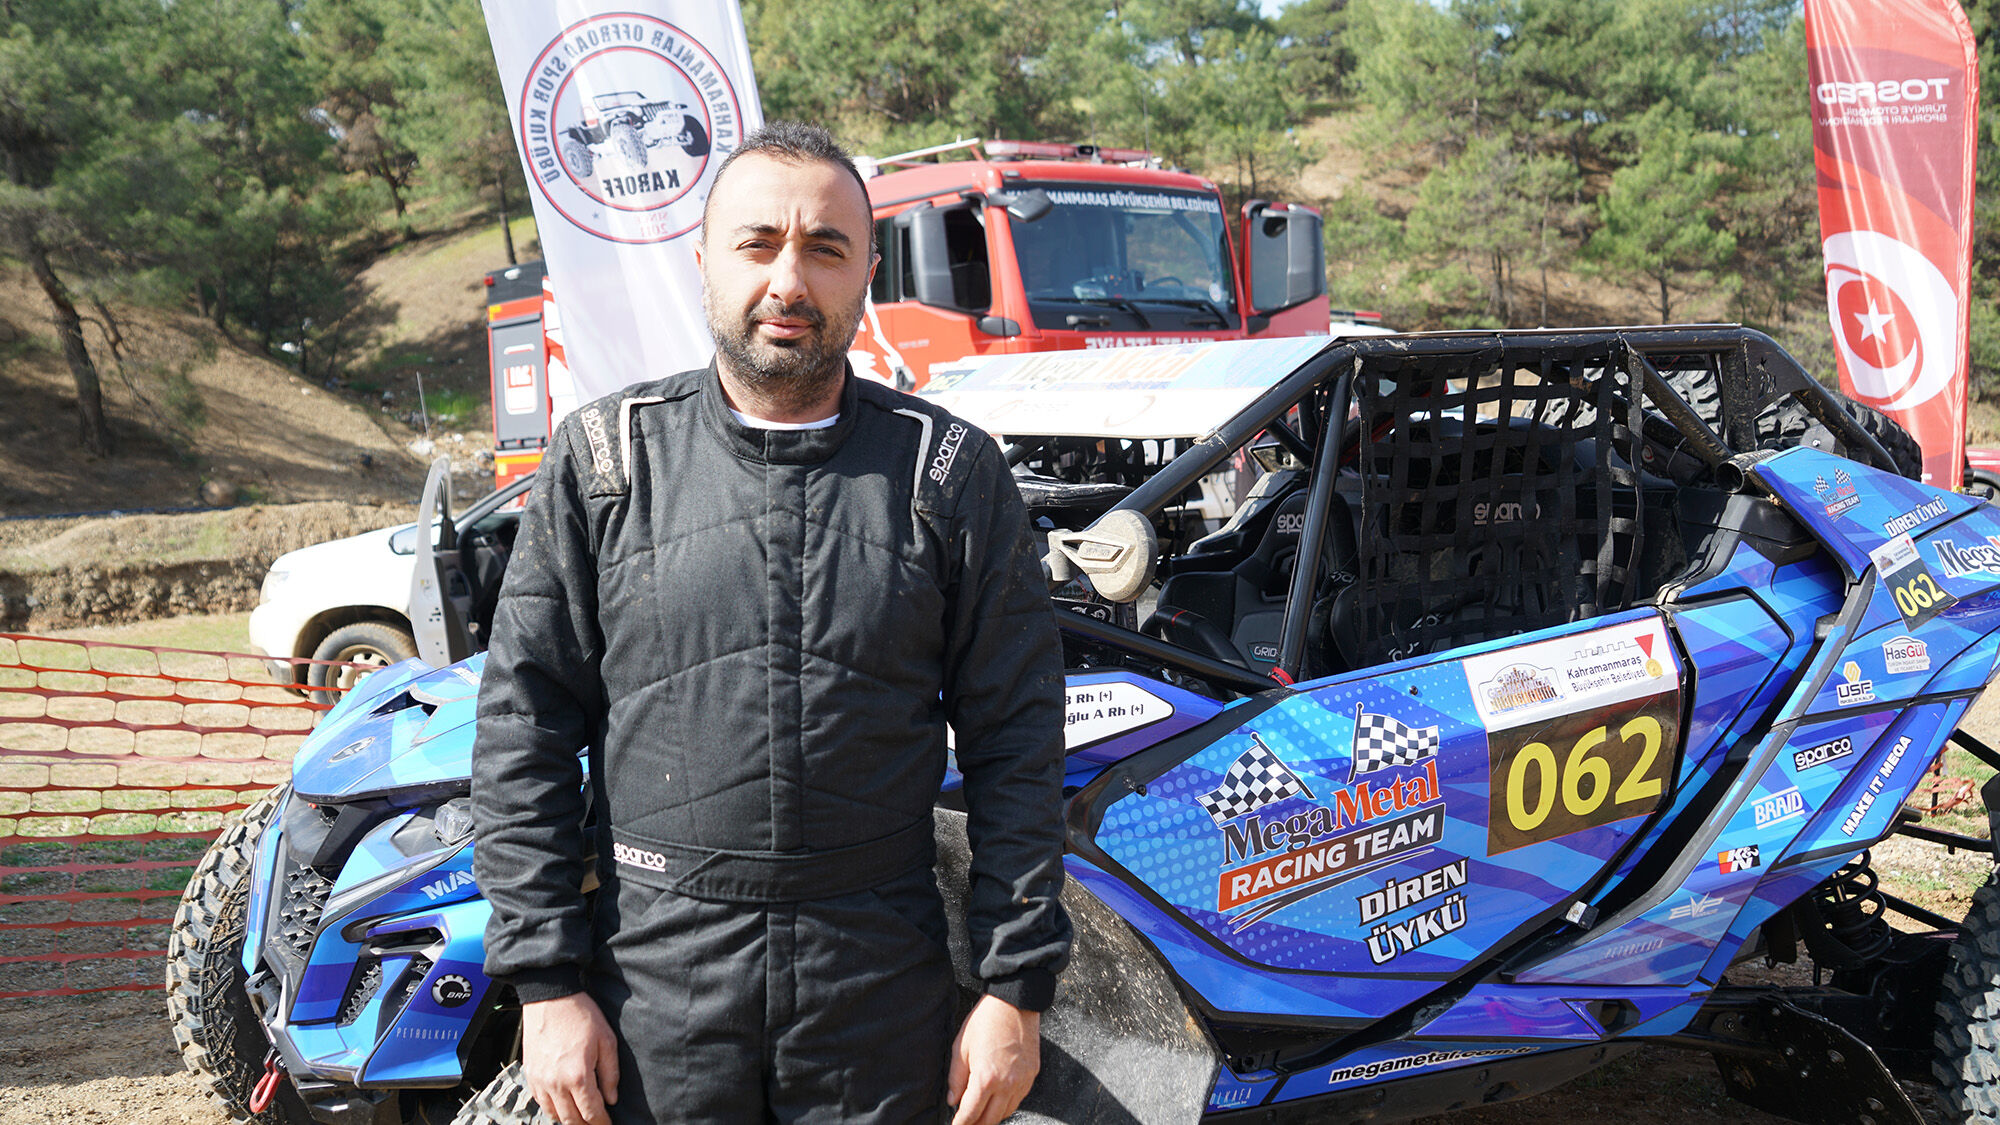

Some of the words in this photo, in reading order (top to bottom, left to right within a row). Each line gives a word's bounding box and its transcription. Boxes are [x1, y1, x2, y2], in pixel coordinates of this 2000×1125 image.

[1110, 191, 1171, 209] BÜYÜKŞEHİR
[580, 405, 614, 475] sparco
[927, 421, 966, 486] sparco
[1884, 511, 1922, 536] DİREN
[1917, 497, 1948, 524] ÜYKÜ
[1933, 537, 2000, 573] Mega
[1895, 573, 1946, 617] 062
[1254, 646, 1277, 658] GRID
[1566, 656, 1642, 679] Kahramanmaraş
[1885, 645, 1925, 660] HasGül
[1572, 677, 1611, 692] Büyükşehir
[1611, 668, 1647, 684] Belediyesi
[1838, 682, 1871, 698] USF
[1076, 693, 1094, 704] Rh
[1067, 711, 1089, 725] ğlu
[1093, 708, 1104, 719] A
[1108, 706, 1126, 717] Rh
[1795, 738, 1852, 771] sparco
[1506, 715, 1662, 831] 062
[1840, 791, 1876, 836] MAKE
[1871, 771, 1887, 795] IT
[1879, 735, 1914, 778] MEGA
[1221, 761, 1440, 866] MegaMetal
[1755, 790, 1803, 825] BRAID
[613, 842, 666, 873] sparco
[1231, 842, 1347, 901] RACING
[1353, 813, 1435, 861] TEAM
[1359, 858, 1468, 925] DİREN
[1366, 896, 1466, 964] ÜYKÜ
[447, 991, 471, 999] BRP
[396, 1026, 458, 1040] PETROLKAFA
[1209, 1088, 1252, 1106] OLKAFA
